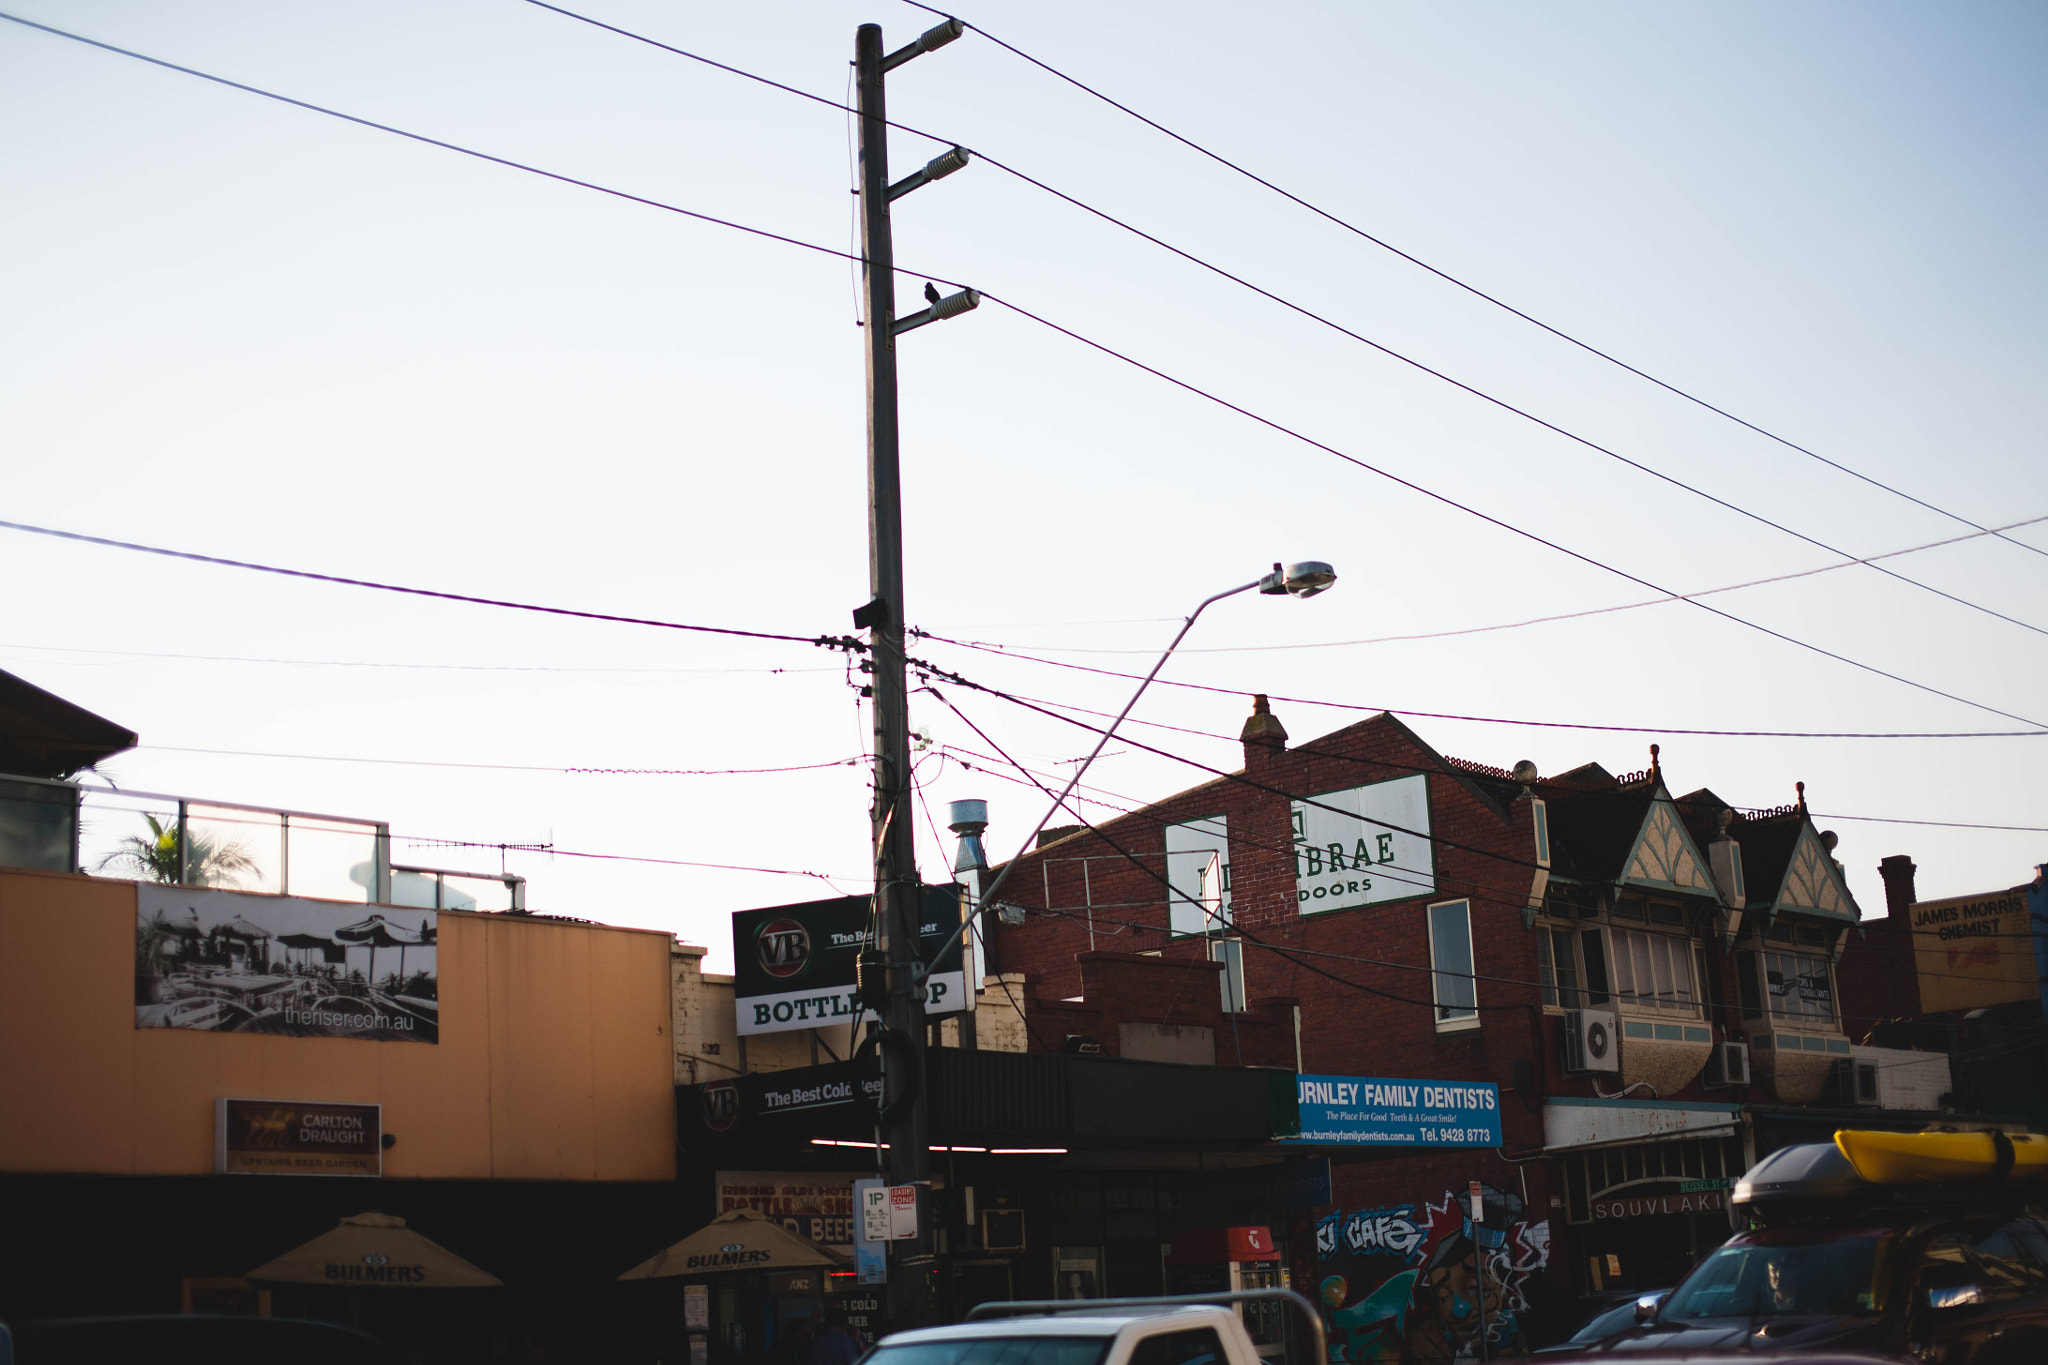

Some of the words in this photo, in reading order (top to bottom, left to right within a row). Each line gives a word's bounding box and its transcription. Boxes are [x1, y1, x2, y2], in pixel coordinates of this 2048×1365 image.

[1299, 879, 1372, 901] DOORS
[1915, 907, 1959, 927] JAMES
[1963, 898, 2023, 919] MORRIS
[831, 933, 854, 945] The
[1939, 918, 2000, 941] CHEMIST
[760, 930, 807, 964] VB
[285, 1007, 414, 1031] theriser.com.au
[705, 1087, 738, 1118] VB
[765, 1092, 792, 1107] The
[792, 1085, 821, 1103] Best
[1364, 1083, 1419, 1108] FAMILY
[1423, 1086, 1496, 1110] DENTISTS
[303, 1114, 363, 1129] CARLTON
[1326, 1110, 1339, 1120] The
[1340, 1111, 1358, 1121] Place
[1359, 1111, 1370, 1121] For
[1371, 1112, 1388, 1122] Good
[1390, 1112, 1408, 1122] Teeth
[1408, 1113, 1414, 1122] &
[1415, 1113, 1420, 1122] A
[1421, 1114, 1438, 1123] Great
[1438, 1113, 1458, 1123] Smile!
[300, 1129, 366, 1145] DRAUGHT
[1420, 1127, 1439, 1142] Tel.
[1440, 1127, 1464, 1142] 9428
[1467, 1128, 1491, 1143] 8773
[241, 1157, 291, 1167] UPSTAIRS
[295, 1158, 323, 1168] BEER
[326, 1159, 367, 1169] GARDEN
[722, 1186, 775, 1196] RISING
[782, 1186, 814, 1196] SUN
[868, 1191, 884, 1205] 1P
[891, 1195, 914, 1204] ZONE
[1596, 1194, 1721, 1219] SOUVLAKI
[810, 1217, 854, 1242] BEER
[687, 1249, 771, 1269] BULMERS
[325, 1263, 425, 1282] BULMERS
[788, 1279, 810, 1291] ANZ
[850, 1299, 878, 1311] COLD
